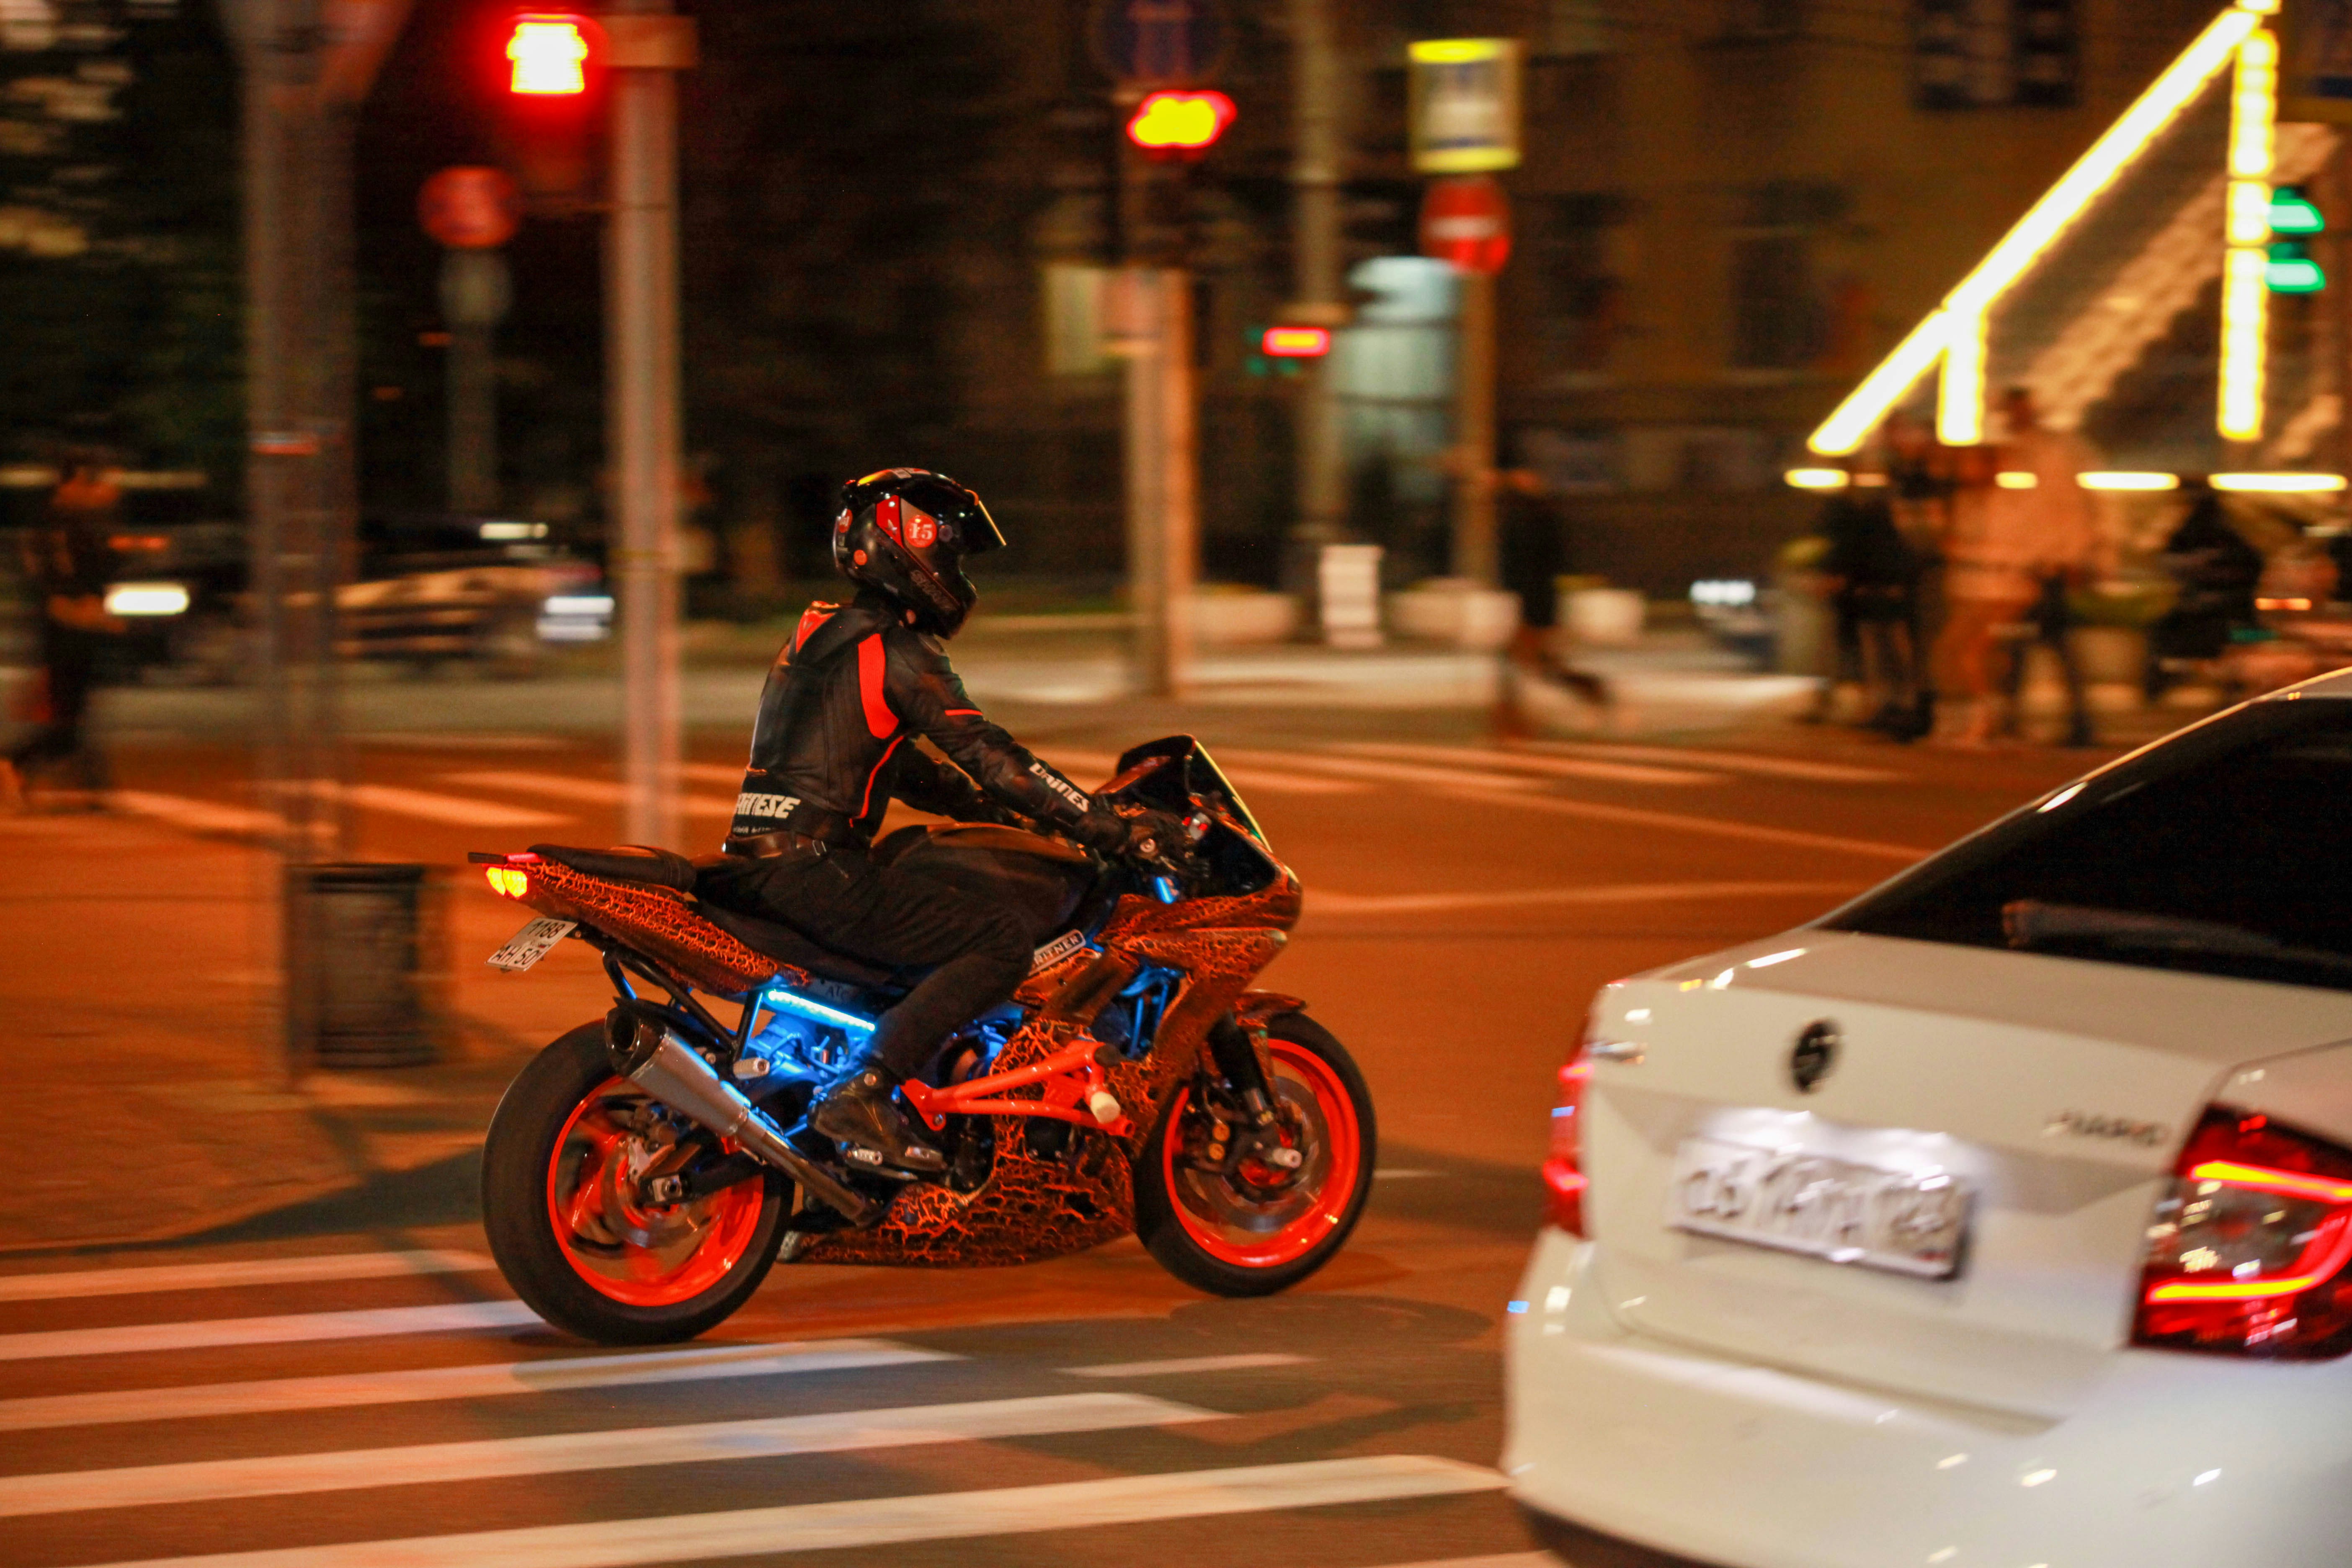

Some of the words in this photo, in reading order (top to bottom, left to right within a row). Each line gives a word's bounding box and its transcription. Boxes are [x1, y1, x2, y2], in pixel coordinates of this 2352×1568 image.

[910, 523, 932, 539] 15
[527, 921, 565, 938] 1188
[514, 949, 539, 965] 50
